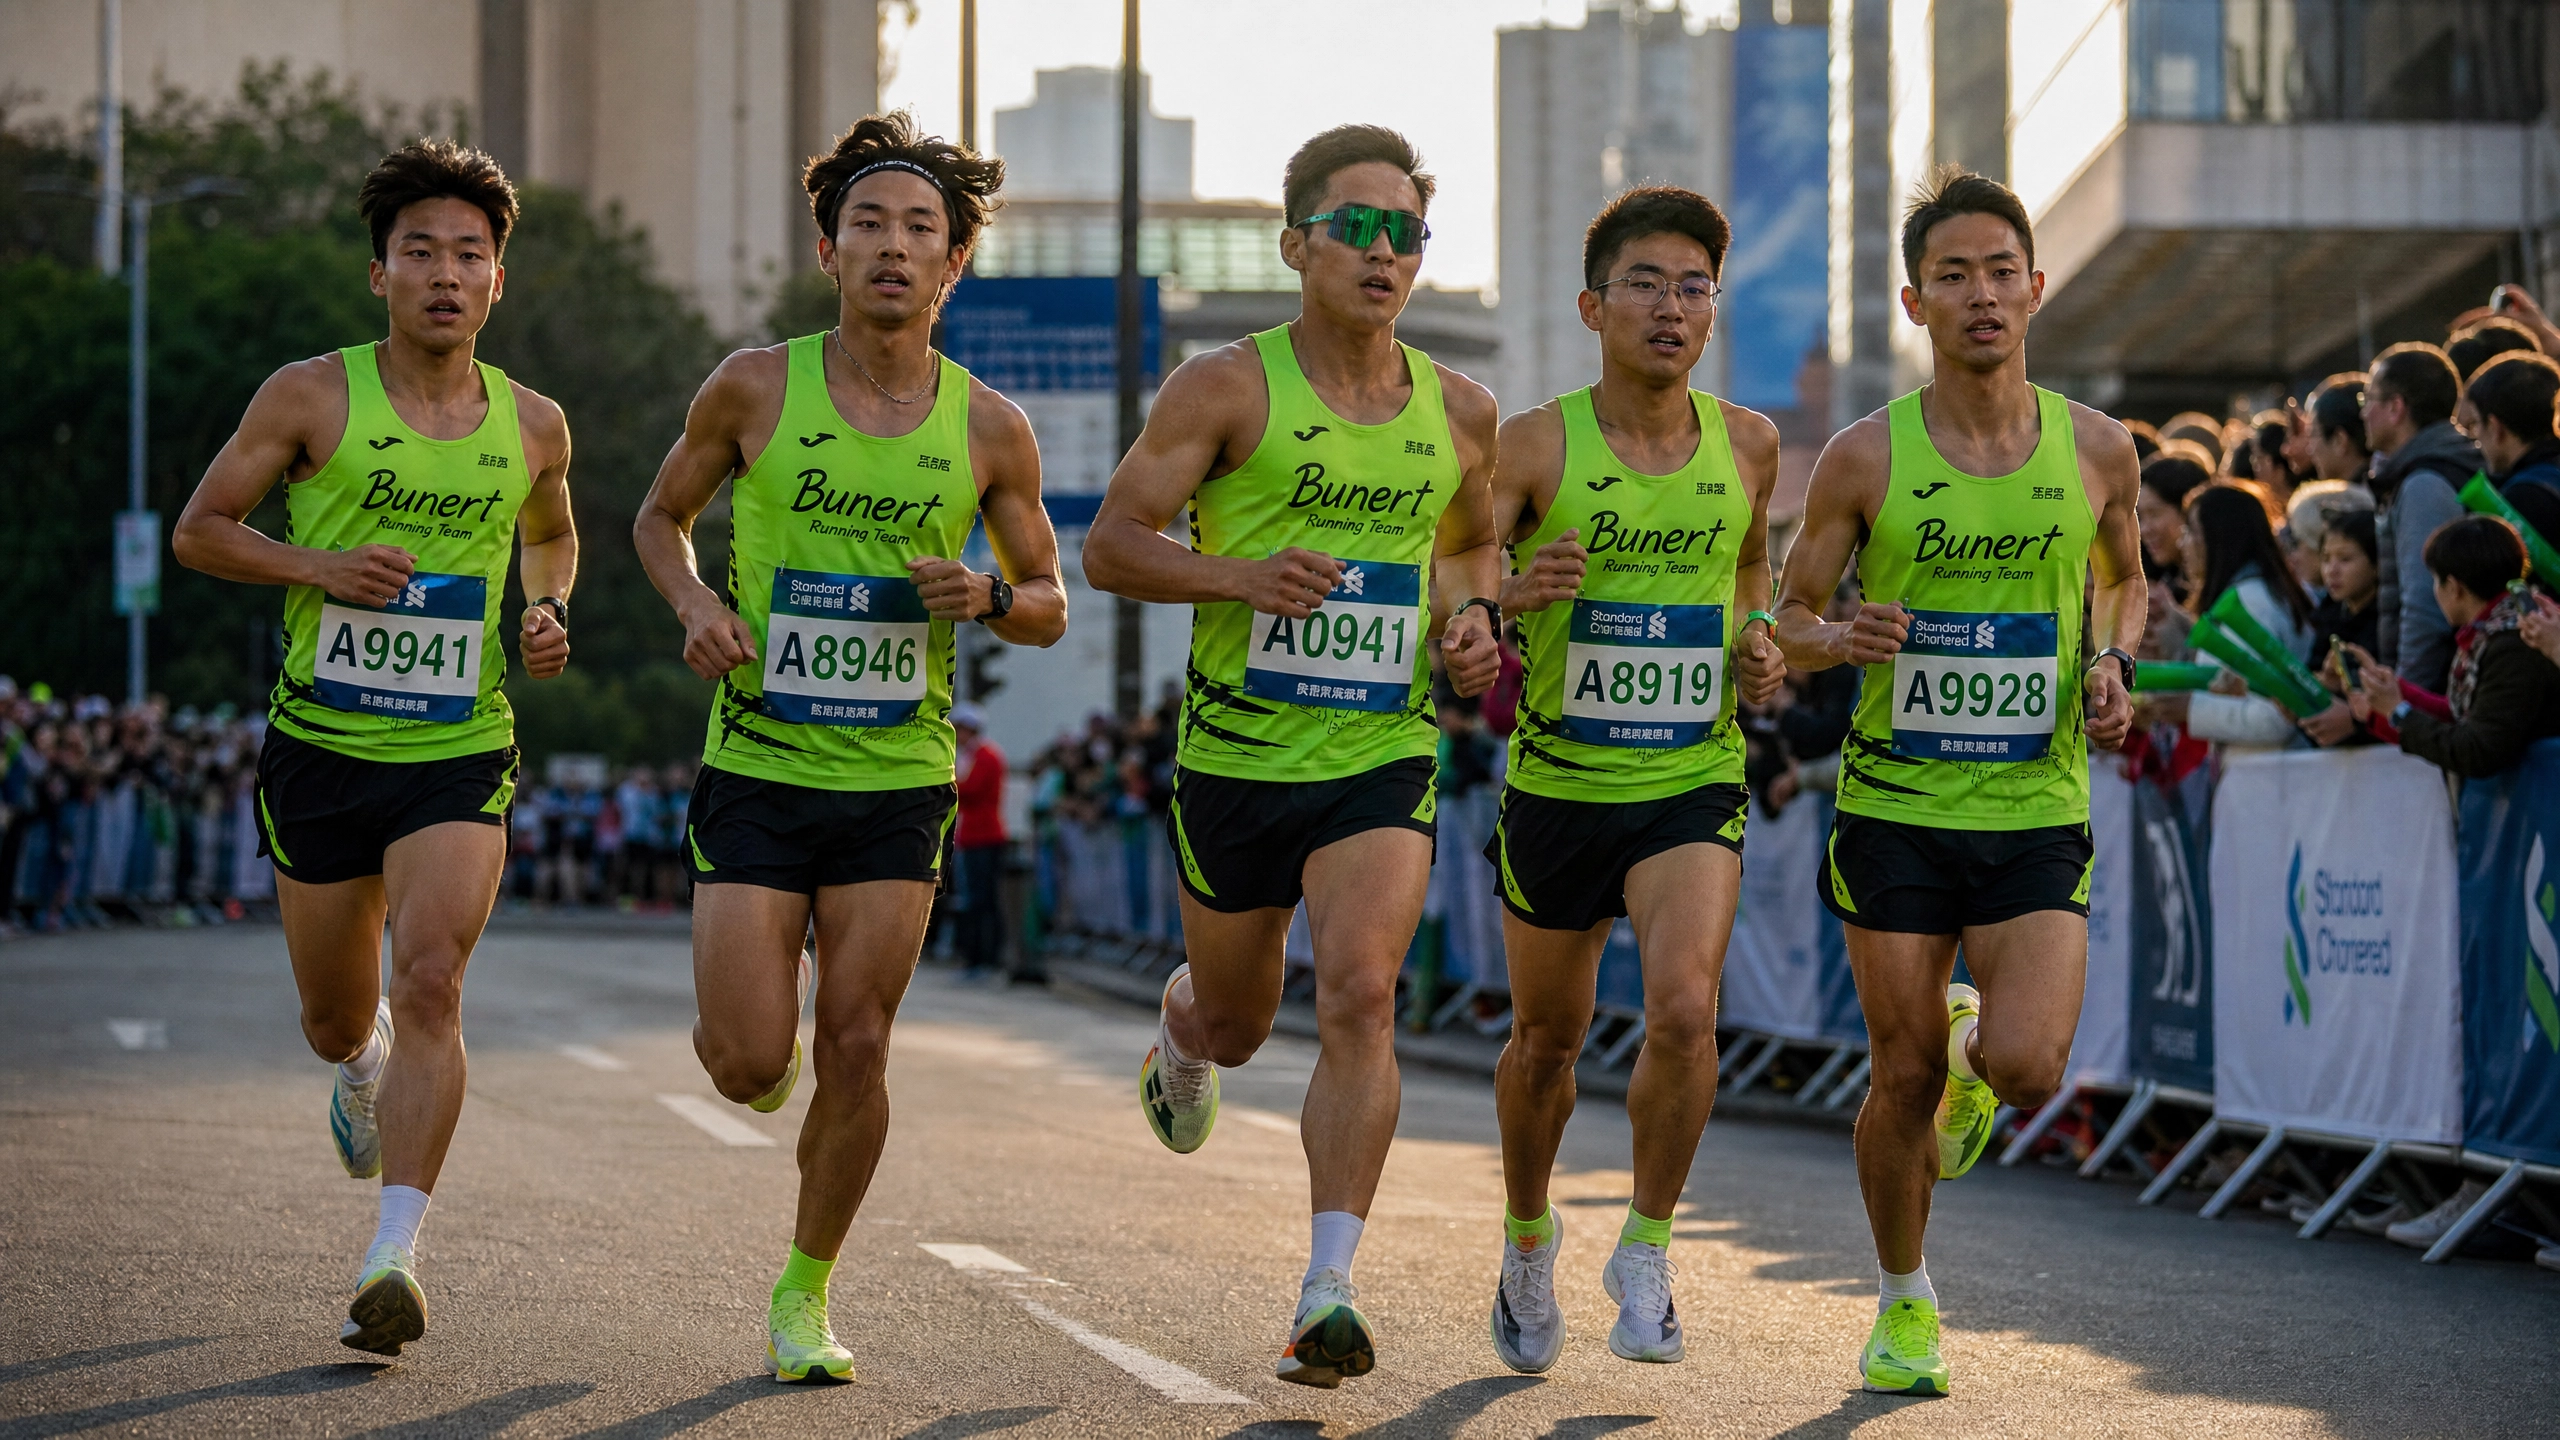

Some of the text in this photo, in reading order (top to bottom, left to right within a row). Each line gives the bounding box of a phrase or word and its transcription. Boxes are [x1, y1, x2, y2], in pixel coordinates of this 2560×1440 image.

[360, 469, 503, 522] Bunert
[791, 468, 943, 528] Bunert
[1288, 463, 1433, 516] Bunert
[377, 516, 472, 540] Running Team
[809, 520, 910, 545] Running Team
[1305, 514, 1404, 536] Running Team
[1586, 511, 1725, 555] Bunert
[1914, 519, 2063, 563] Bunert
[1603, 559, 1698, 577] Running Team
[1932, 566, 2033, 583] Running Team
[327, 622, 468, 678] A9941
[775, 632, 916, 682] A8946
[1262, 611, 1404, 664] A0941
[1574, 660, 1711, 705] A8919
[1904, 670, 2046, 716] A9928
